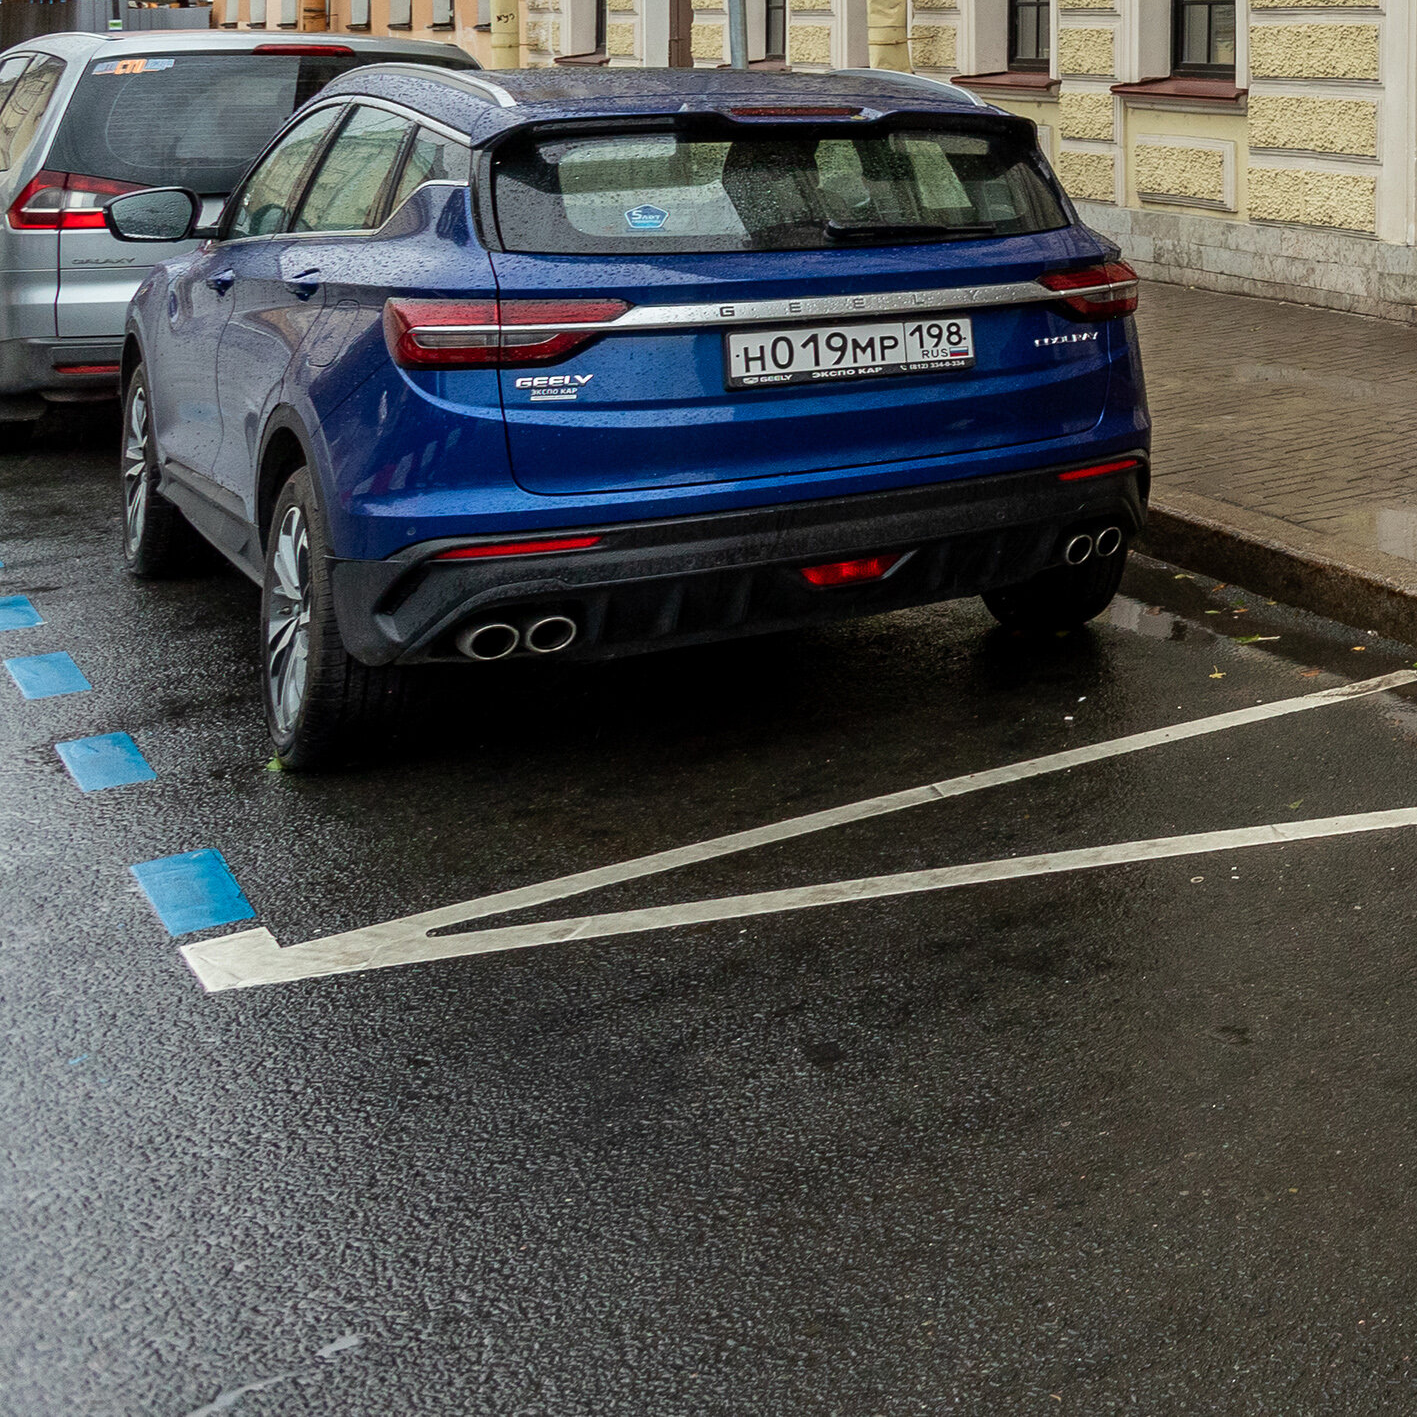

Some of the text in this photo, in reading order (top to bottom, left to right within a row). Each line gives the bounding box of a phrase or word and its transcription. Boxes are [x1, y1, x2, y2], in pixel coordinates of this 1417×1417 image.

[908, 322, 963, 350] 198
[921, 348, 949, 359] RUS
[760, 373, 793, 383] GEELY
[812, 366, 883, 379] ЭКСПО КАР
[515, 373, 595, 389] GEELY
[531, 388, 559, 396] ЭКСПО
